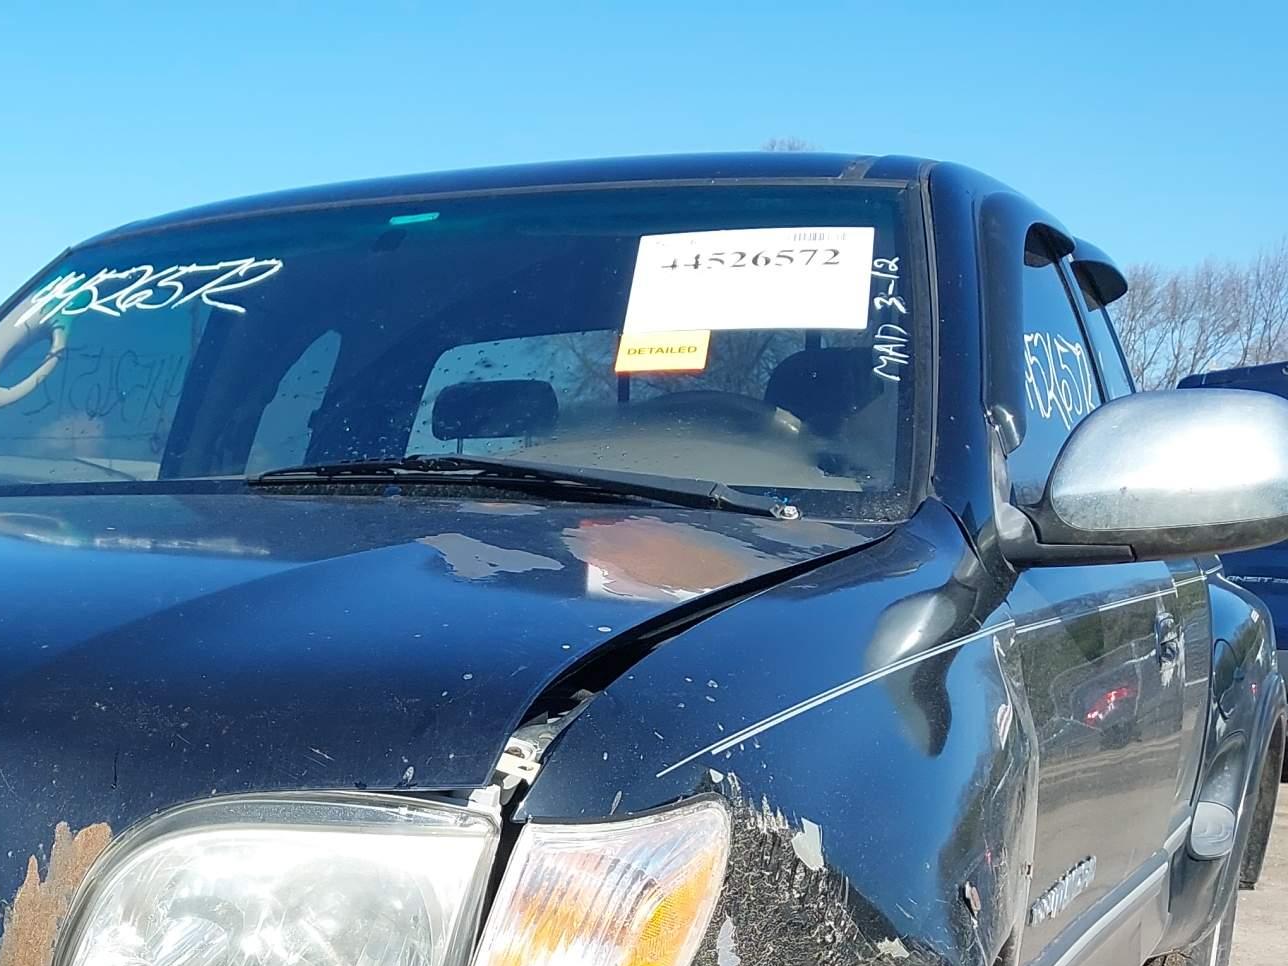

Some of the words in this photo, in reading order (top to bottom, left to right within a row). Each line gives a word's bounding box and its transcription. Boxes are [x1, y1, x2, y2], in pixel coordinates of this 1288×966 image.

[661, 248, 842, 271] 44526572
[872, 255, 909, 315] 3-12
[626, 345, 699, 357] DETAILED
[872, 322, 912, 382] MAD
